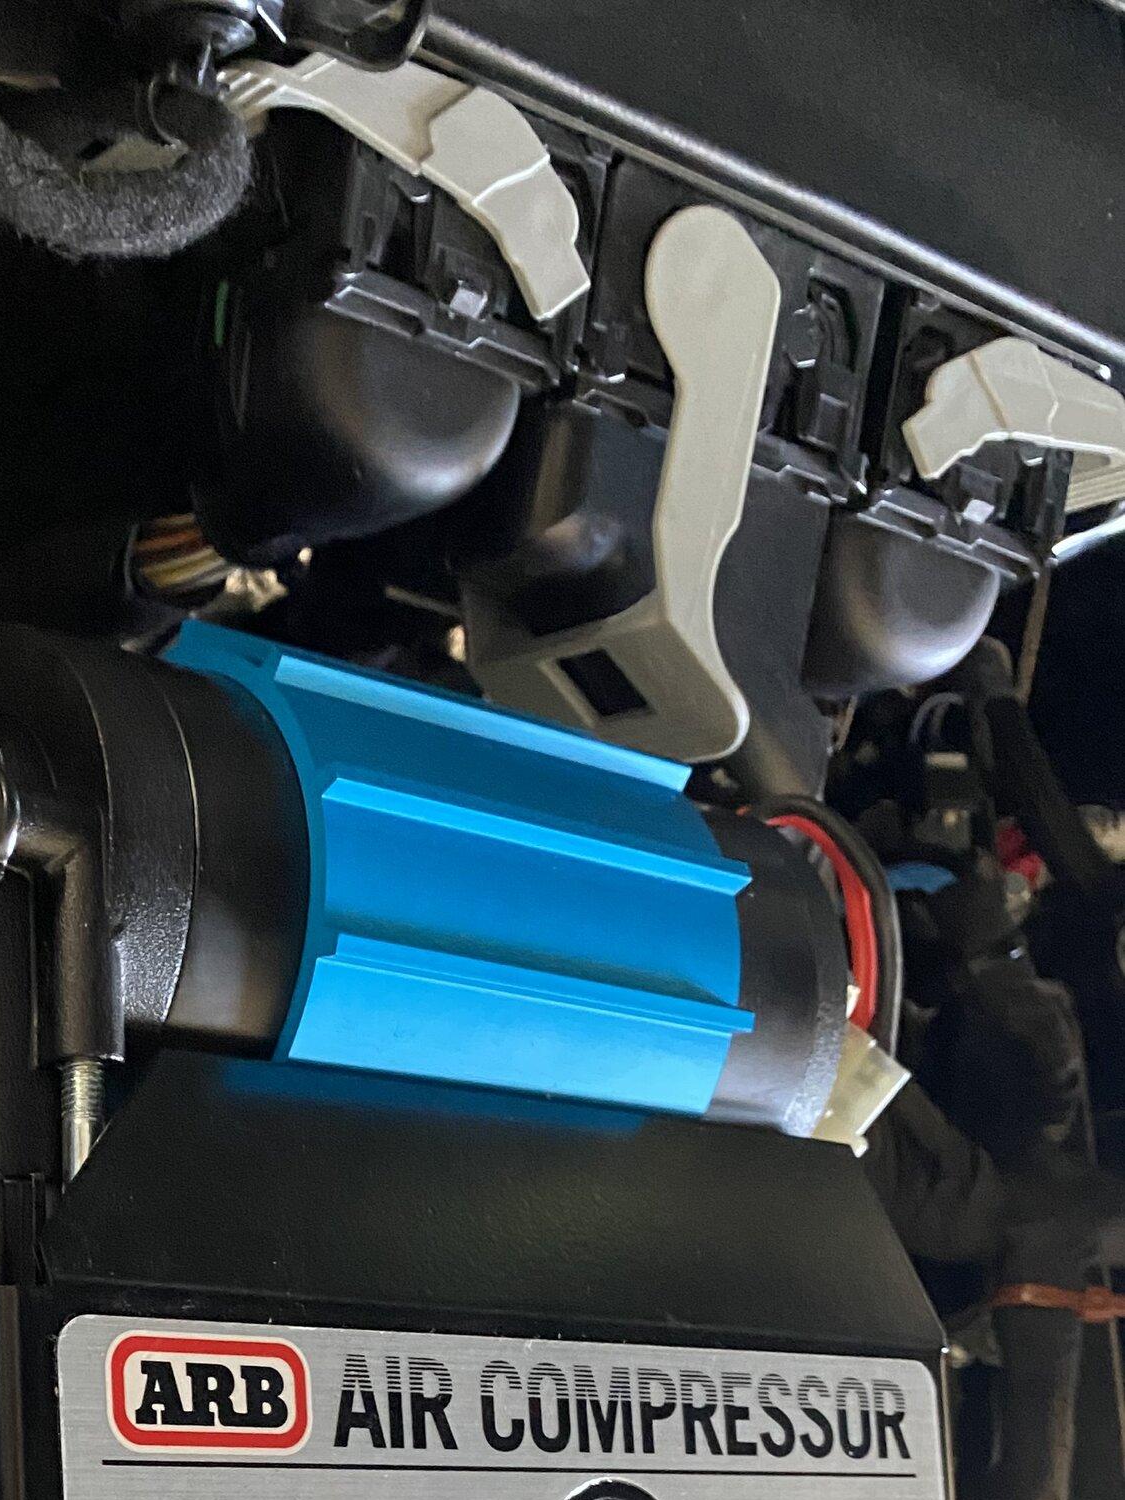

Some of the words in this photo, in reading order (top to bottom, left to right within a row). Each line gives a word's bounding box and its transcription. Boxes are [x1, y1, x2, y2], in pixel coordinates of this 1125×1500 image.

[135, 1360, 289, 1428] ARB
[333, 1354, 459, 1450] AIR
[480, 1360, 910, 1459] COMPRESSOR
